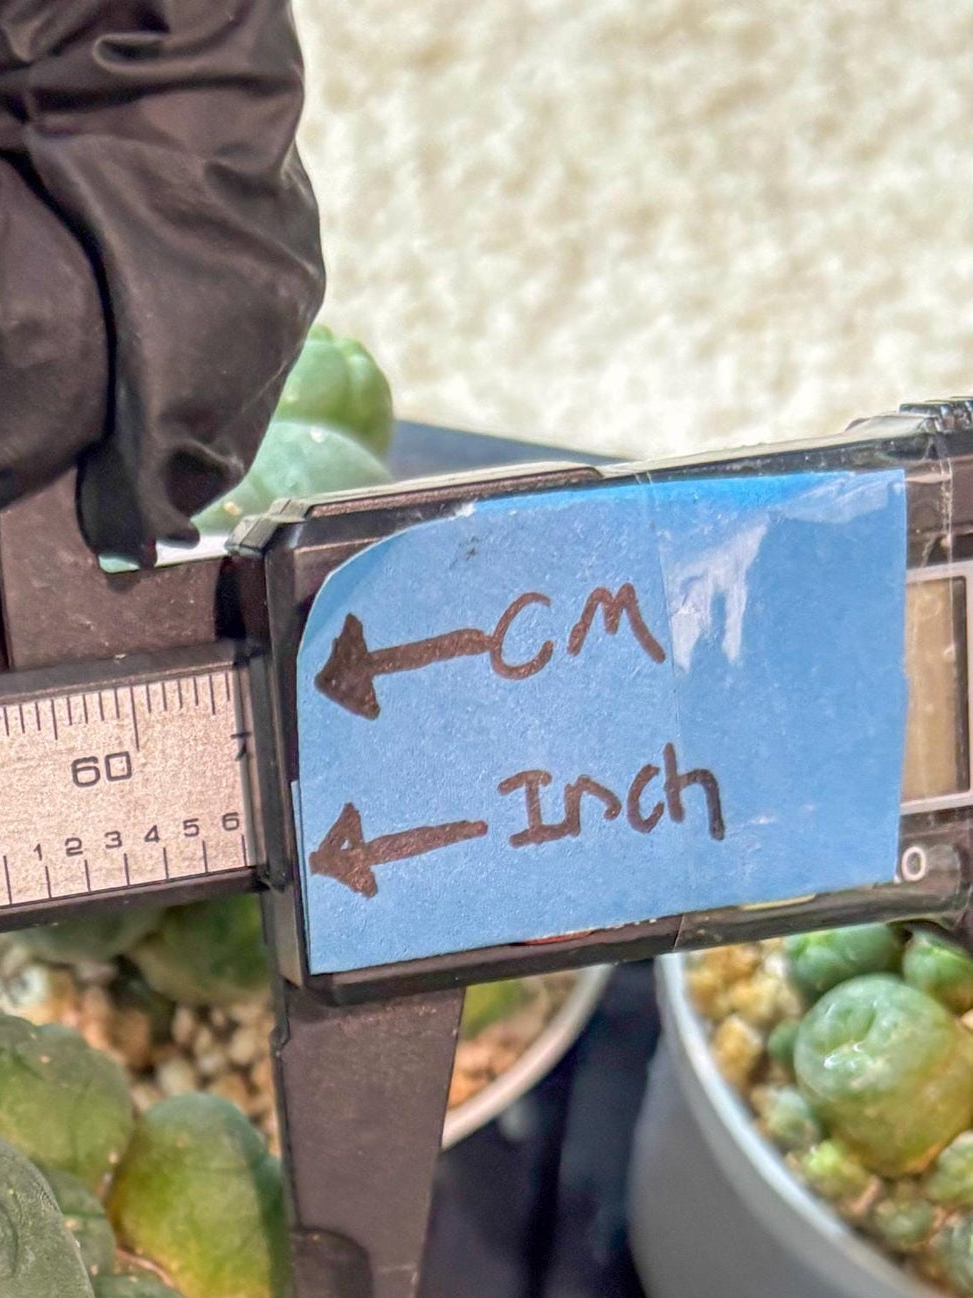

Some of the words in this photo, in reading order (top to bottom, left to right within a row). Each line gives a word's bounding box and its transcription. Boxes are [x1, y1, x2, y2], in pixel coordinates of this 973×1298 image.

[70, 750, 132, 787] 60
[498, 743, 724, 848] Inch
[32, 843, 44, 861] 1
[65, 837, 83, 857] 2
[105, 831, 123, 849] 3
[144, 824, 161, 843] 4
[182, 818, 201, 838] 5
[221, 812, 240, 831] 6
